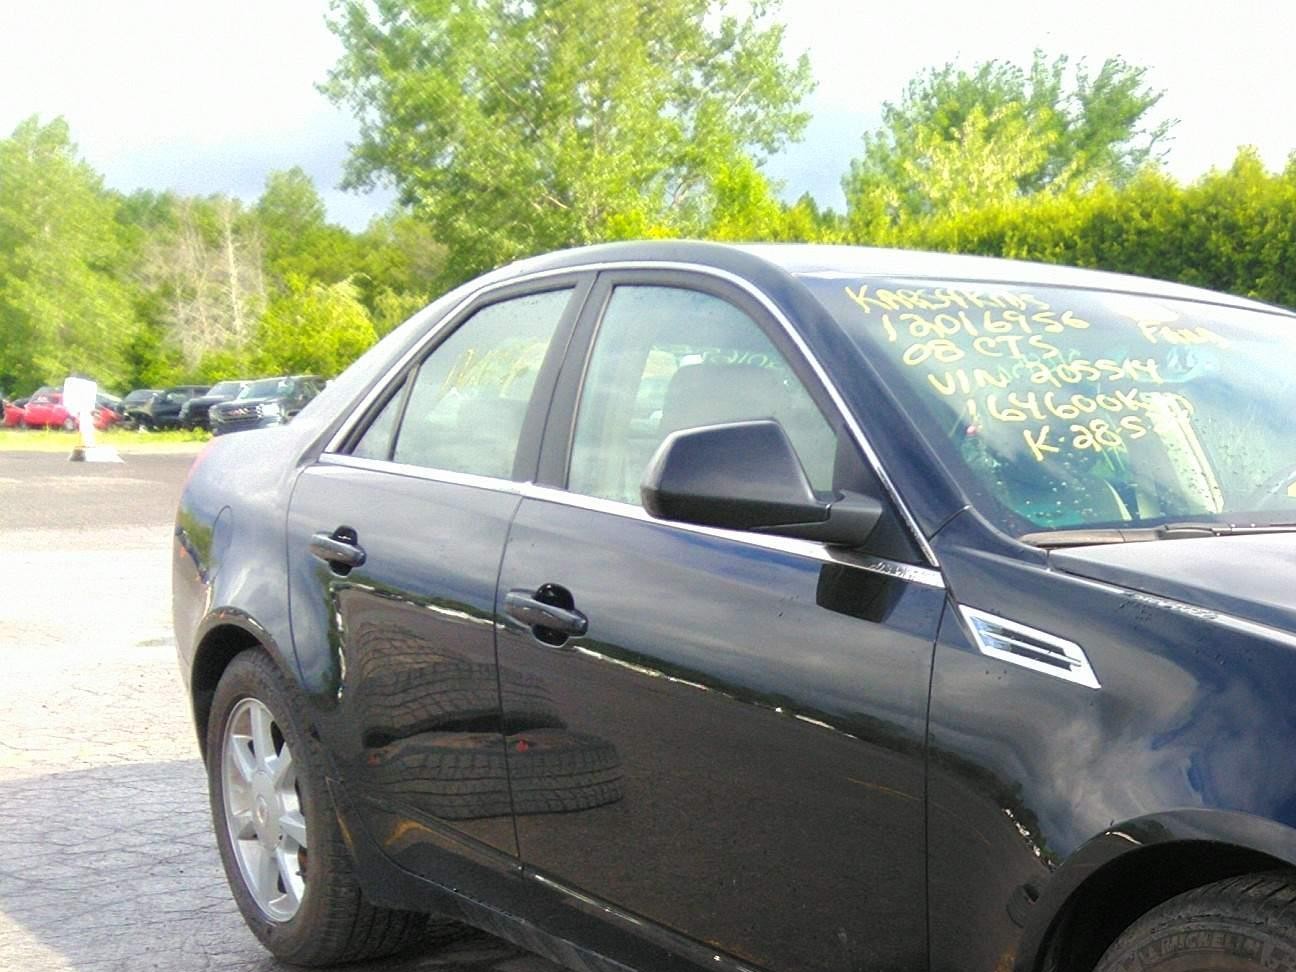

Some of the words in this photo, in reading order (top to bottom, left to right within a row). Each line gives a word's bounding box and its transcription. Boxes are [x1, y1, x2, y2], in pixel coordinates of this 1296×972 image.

[881, 310, 1091, 342] 12016956
[902, 338, 965, 367] 08
[972, 335, 1058, 360] CTS
[927, 367, 1009, 396] VIN
